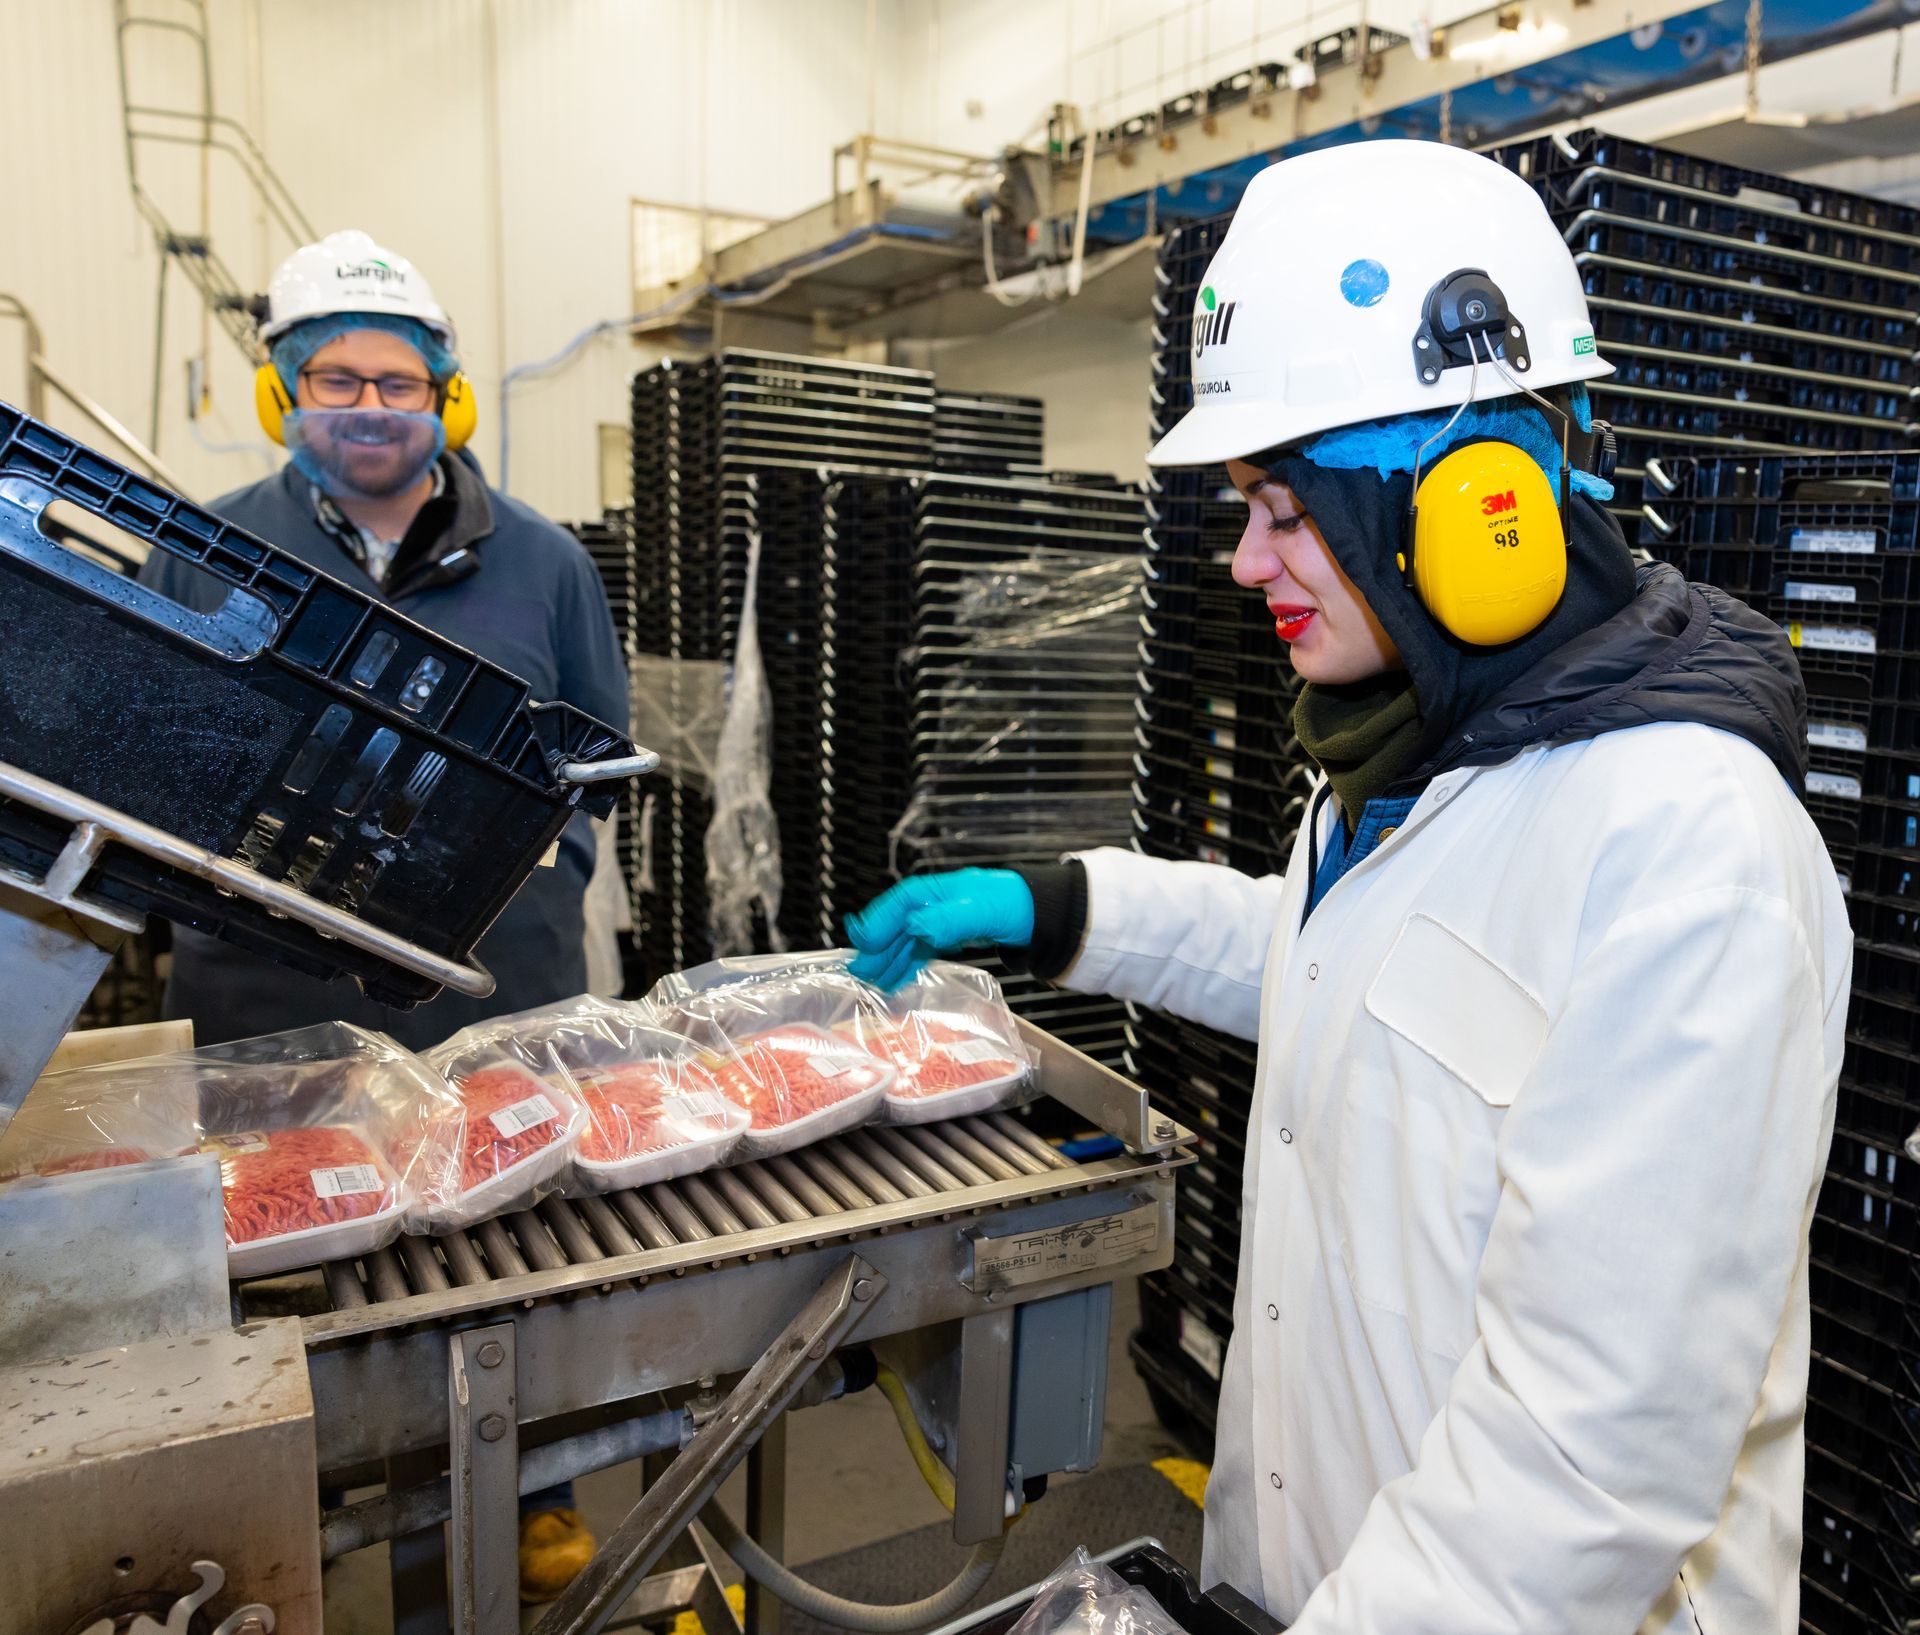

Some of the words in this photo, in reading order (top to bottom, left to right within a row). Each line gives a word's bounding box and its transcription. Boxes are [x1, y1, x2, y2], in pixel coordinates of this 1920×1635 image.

[1481, 490, 1517, 515] 3M
[1488, 516, 1519, 528] OPTIME
[1494, 529, 1520, 550] 98
